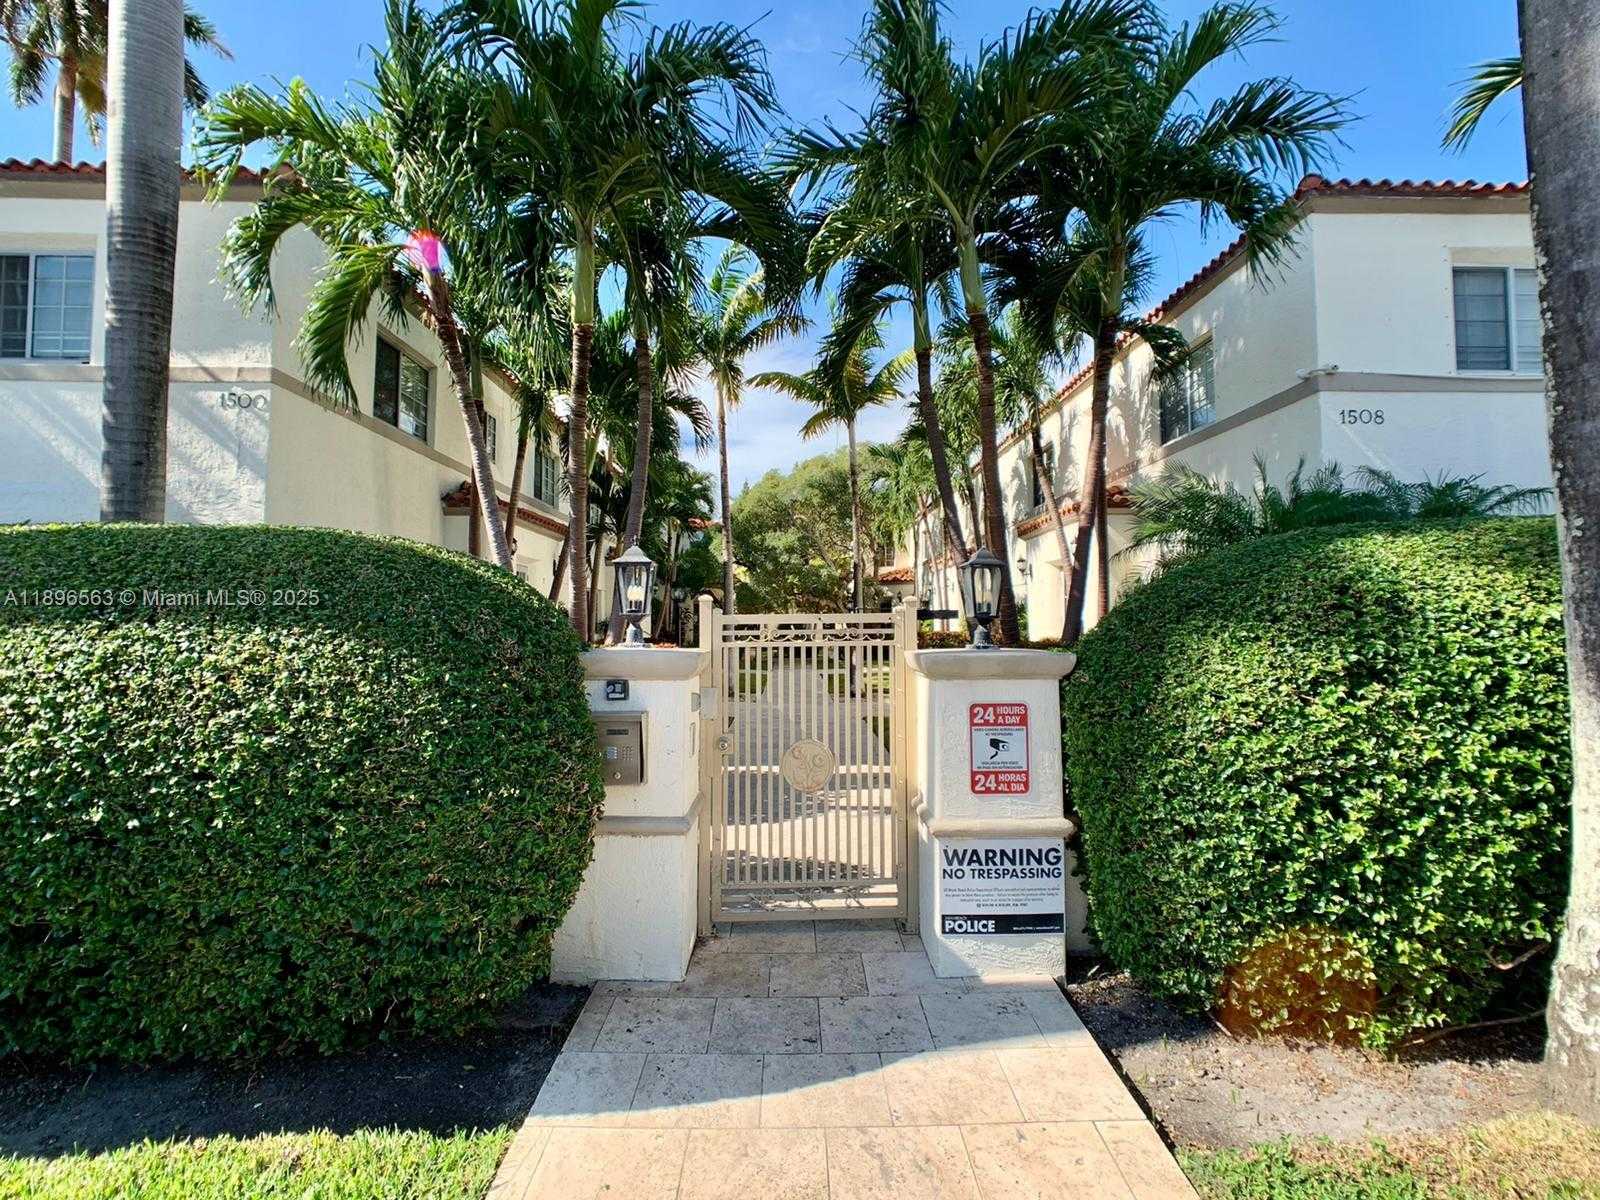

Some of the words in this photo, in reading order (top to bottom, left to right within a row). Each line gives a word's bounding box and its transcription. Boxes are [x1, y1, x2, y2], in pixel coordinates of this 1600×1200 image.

[1339, 409, 1385, 425] 1508
[973, 706, 996, 724] 24
[996, 706, 1026, 715] HOURS
[997, 715, 1004, 724] A
[1005, 715, 1021, 724] DAY
[974, 774, 997, 791] 24
[998, 773, 1027, 782] HORAS
[998, 783, 1009, 792] AL
[943, 847, 1062, 867] WARNING
[943, 868, 966, 880] NO
[970, 867, 1062, 880] TRESPASSING
[944, 920, 996, 934] POLICE
